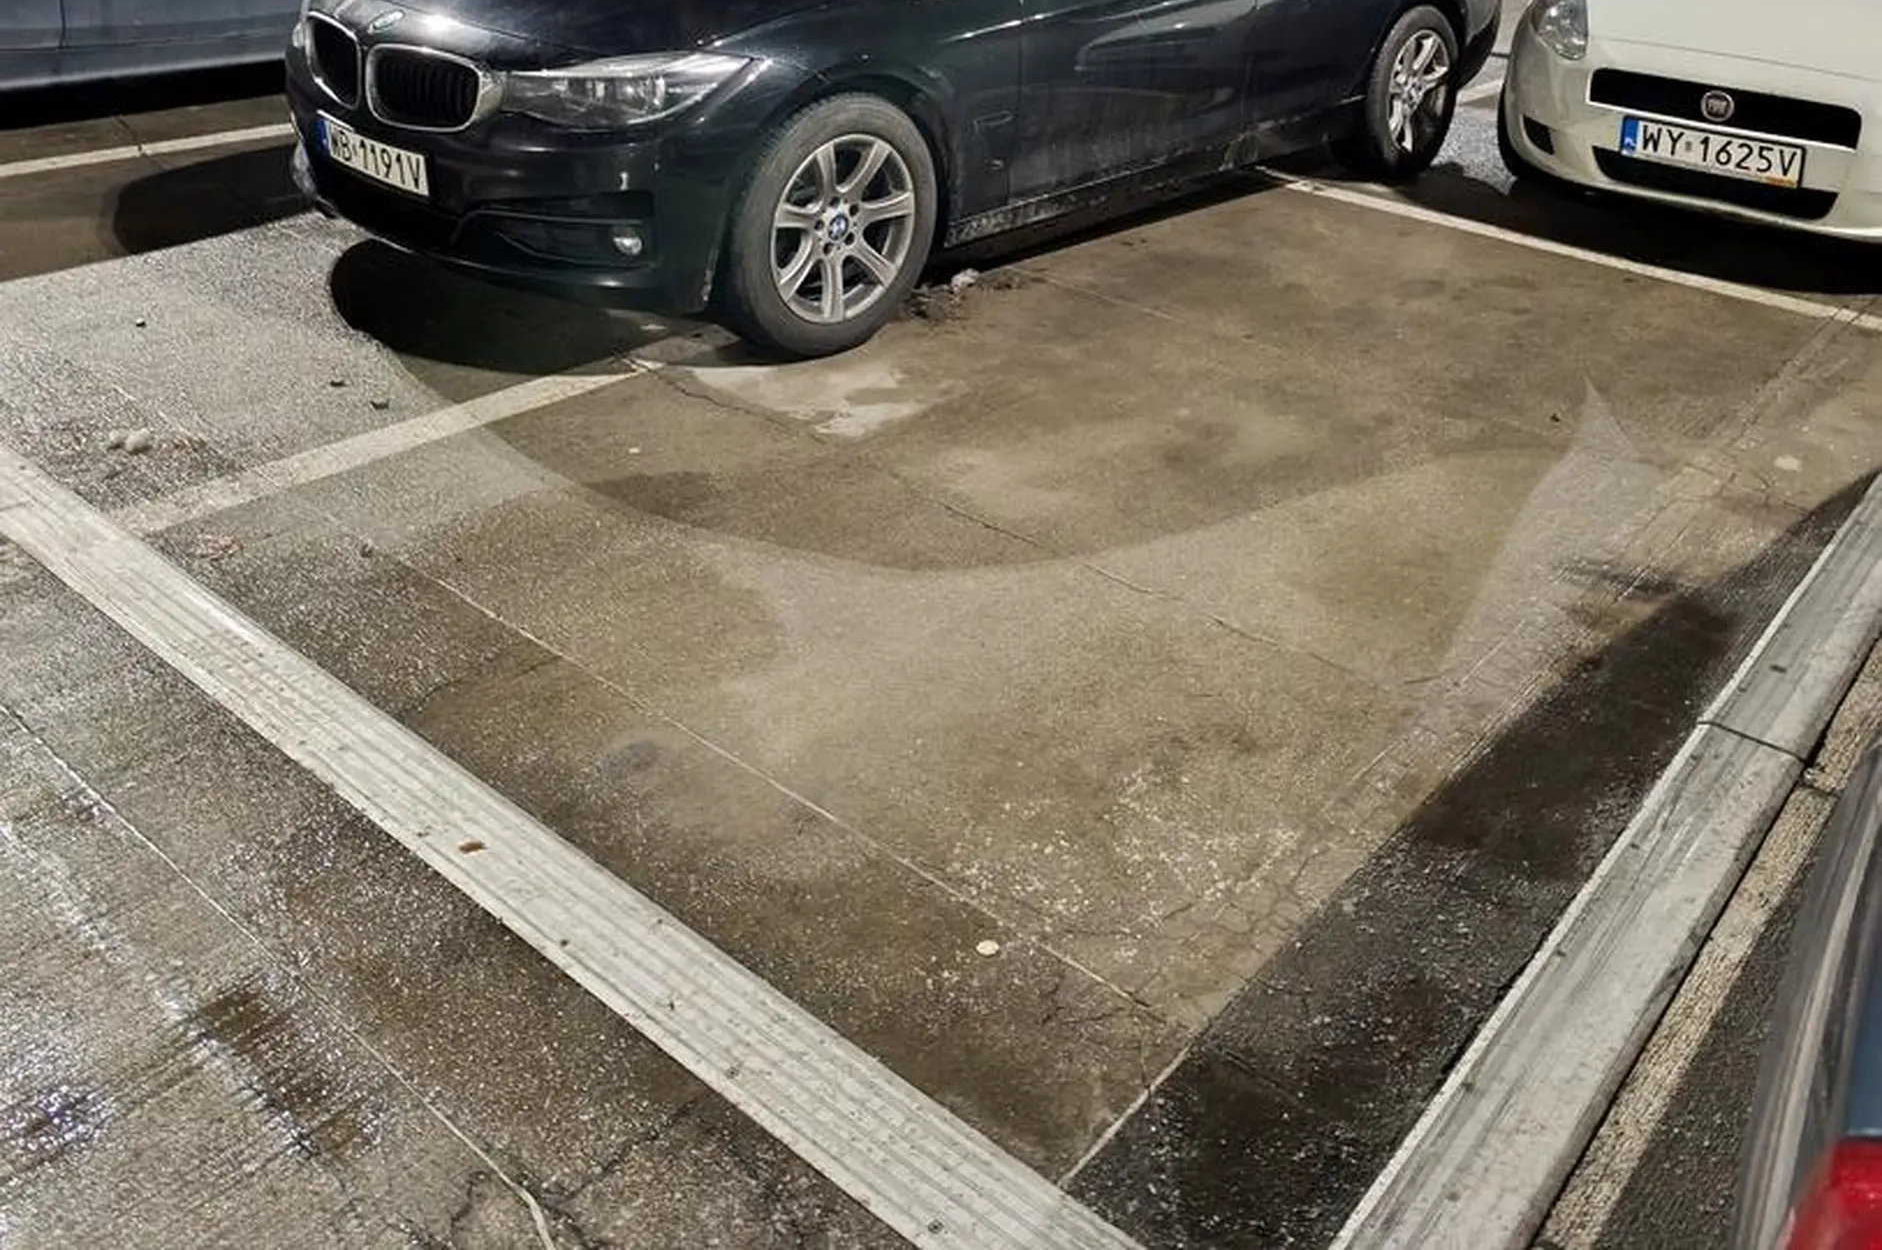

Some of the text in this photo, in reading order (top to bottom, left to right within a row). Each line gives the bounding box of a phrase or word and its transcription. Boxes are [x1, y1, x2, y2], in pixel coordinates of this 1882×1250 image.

[359, 138, 421, 190] 1191V
[1642, 124, 1798, 177] WY 1625V
